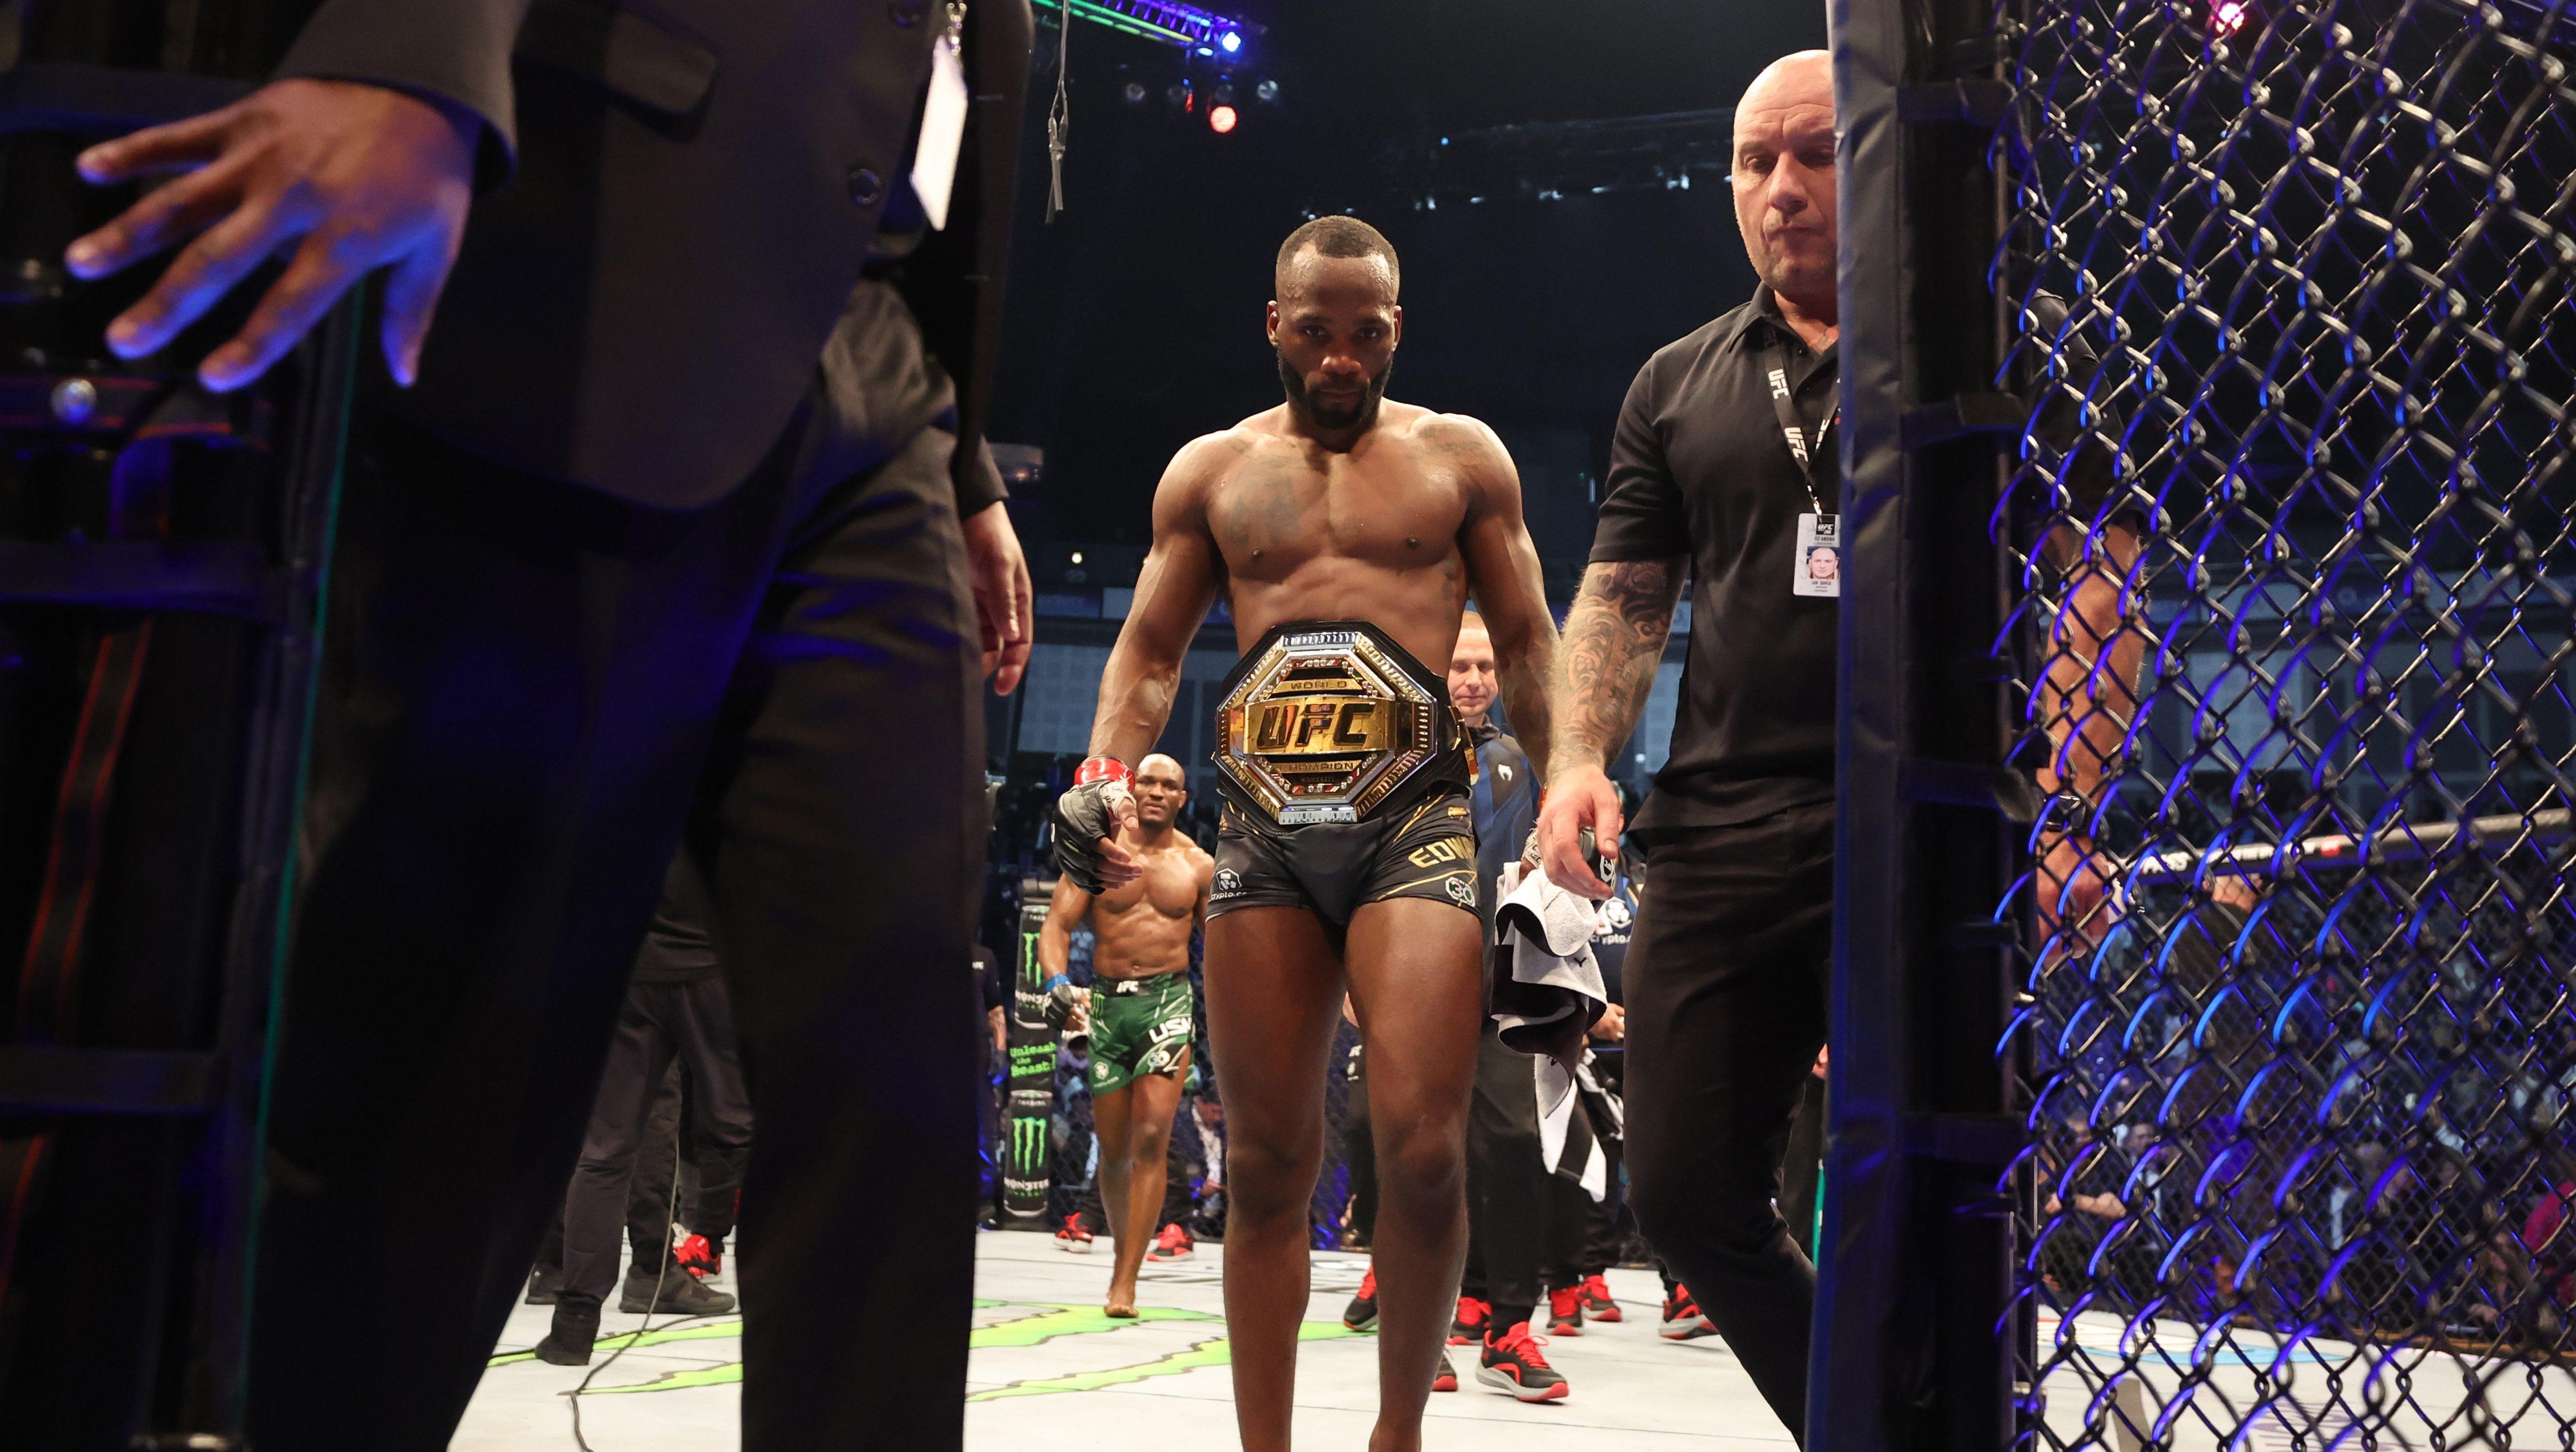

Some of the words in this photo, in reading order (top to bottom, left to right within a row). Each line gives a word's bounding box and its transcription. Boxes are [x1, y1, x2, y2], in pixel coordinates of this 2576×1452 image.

[1768, 368, 1789, 399] UFC
[1784, 427, 1808, 462] UFC
[1291, 681, 1347, 689] WORLD
[1257, 702, 1376, 749] UFC
